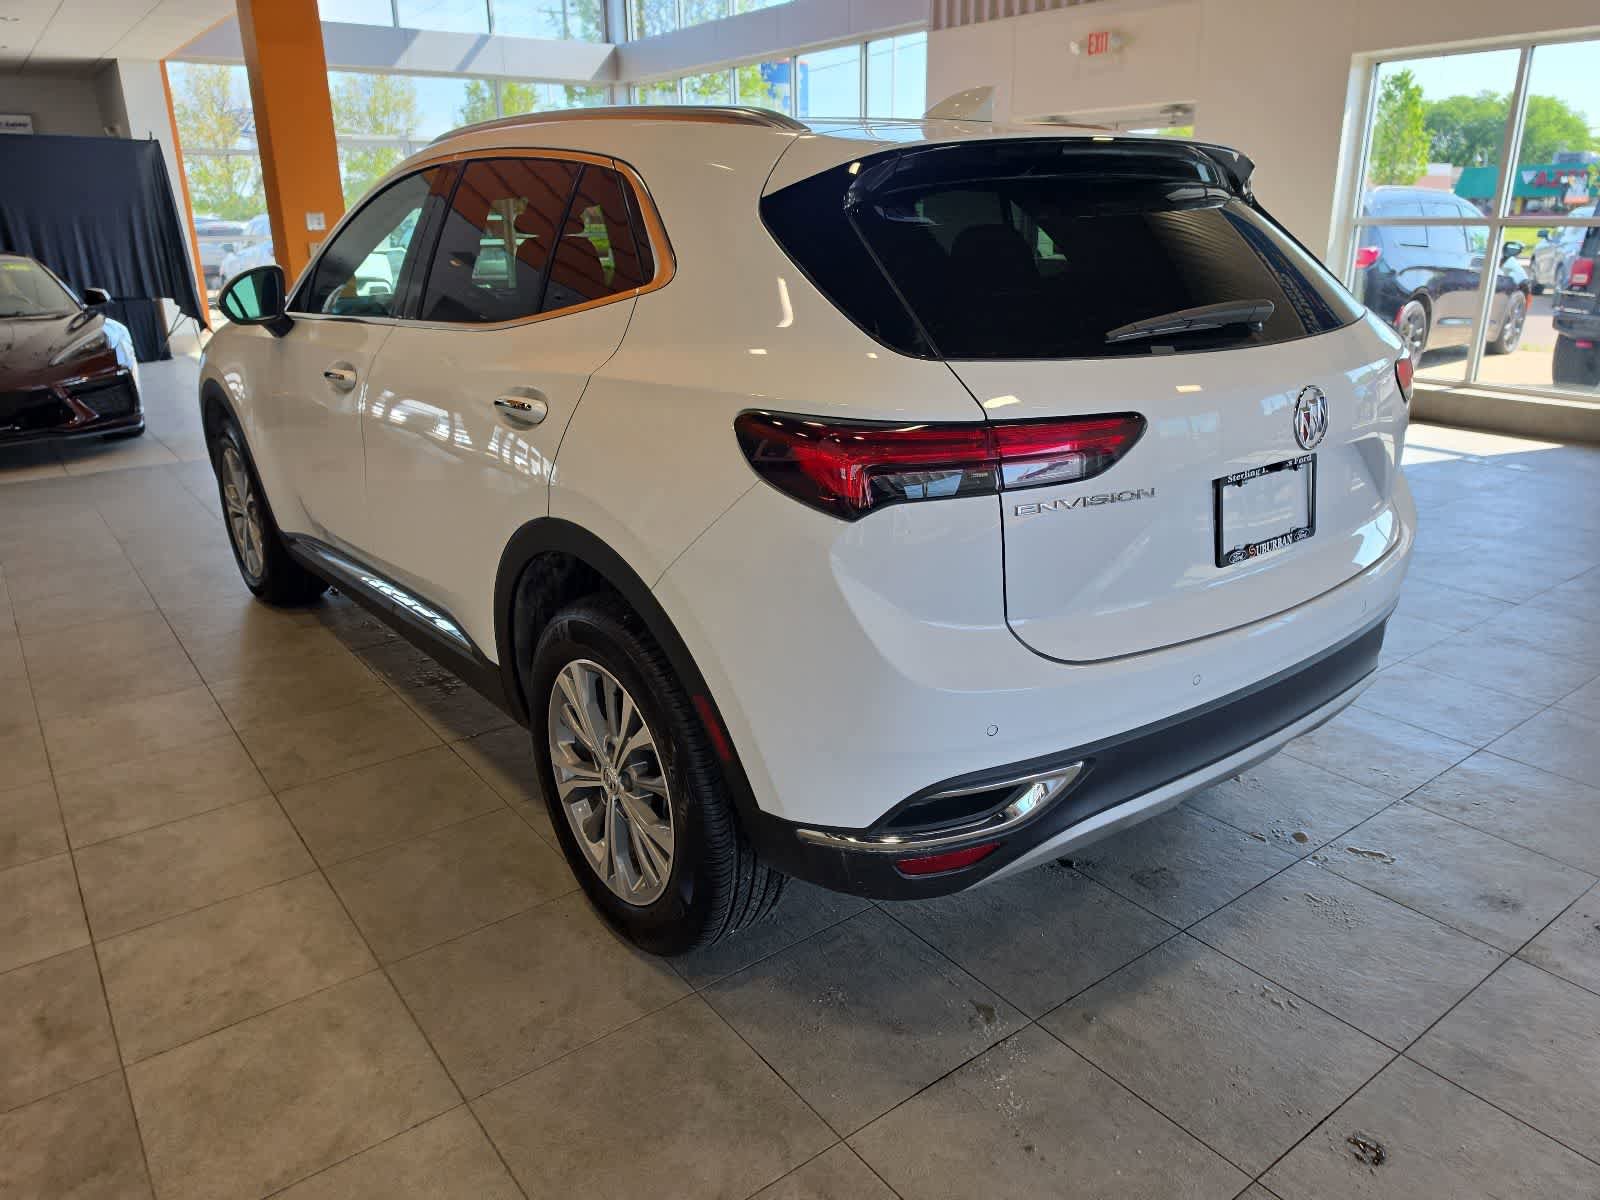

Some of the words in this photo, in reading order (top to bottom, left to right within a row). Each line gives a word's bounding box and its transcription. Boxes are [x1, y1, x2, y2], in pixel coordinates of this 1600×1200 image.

[1088, 32, 1109, 56] EXIT
[1227, 468, 1261, 484] Sterling
[1014, 487, 1156, 517] ENVISION
[1248, 534, 1293, 557] SUBURBAN
